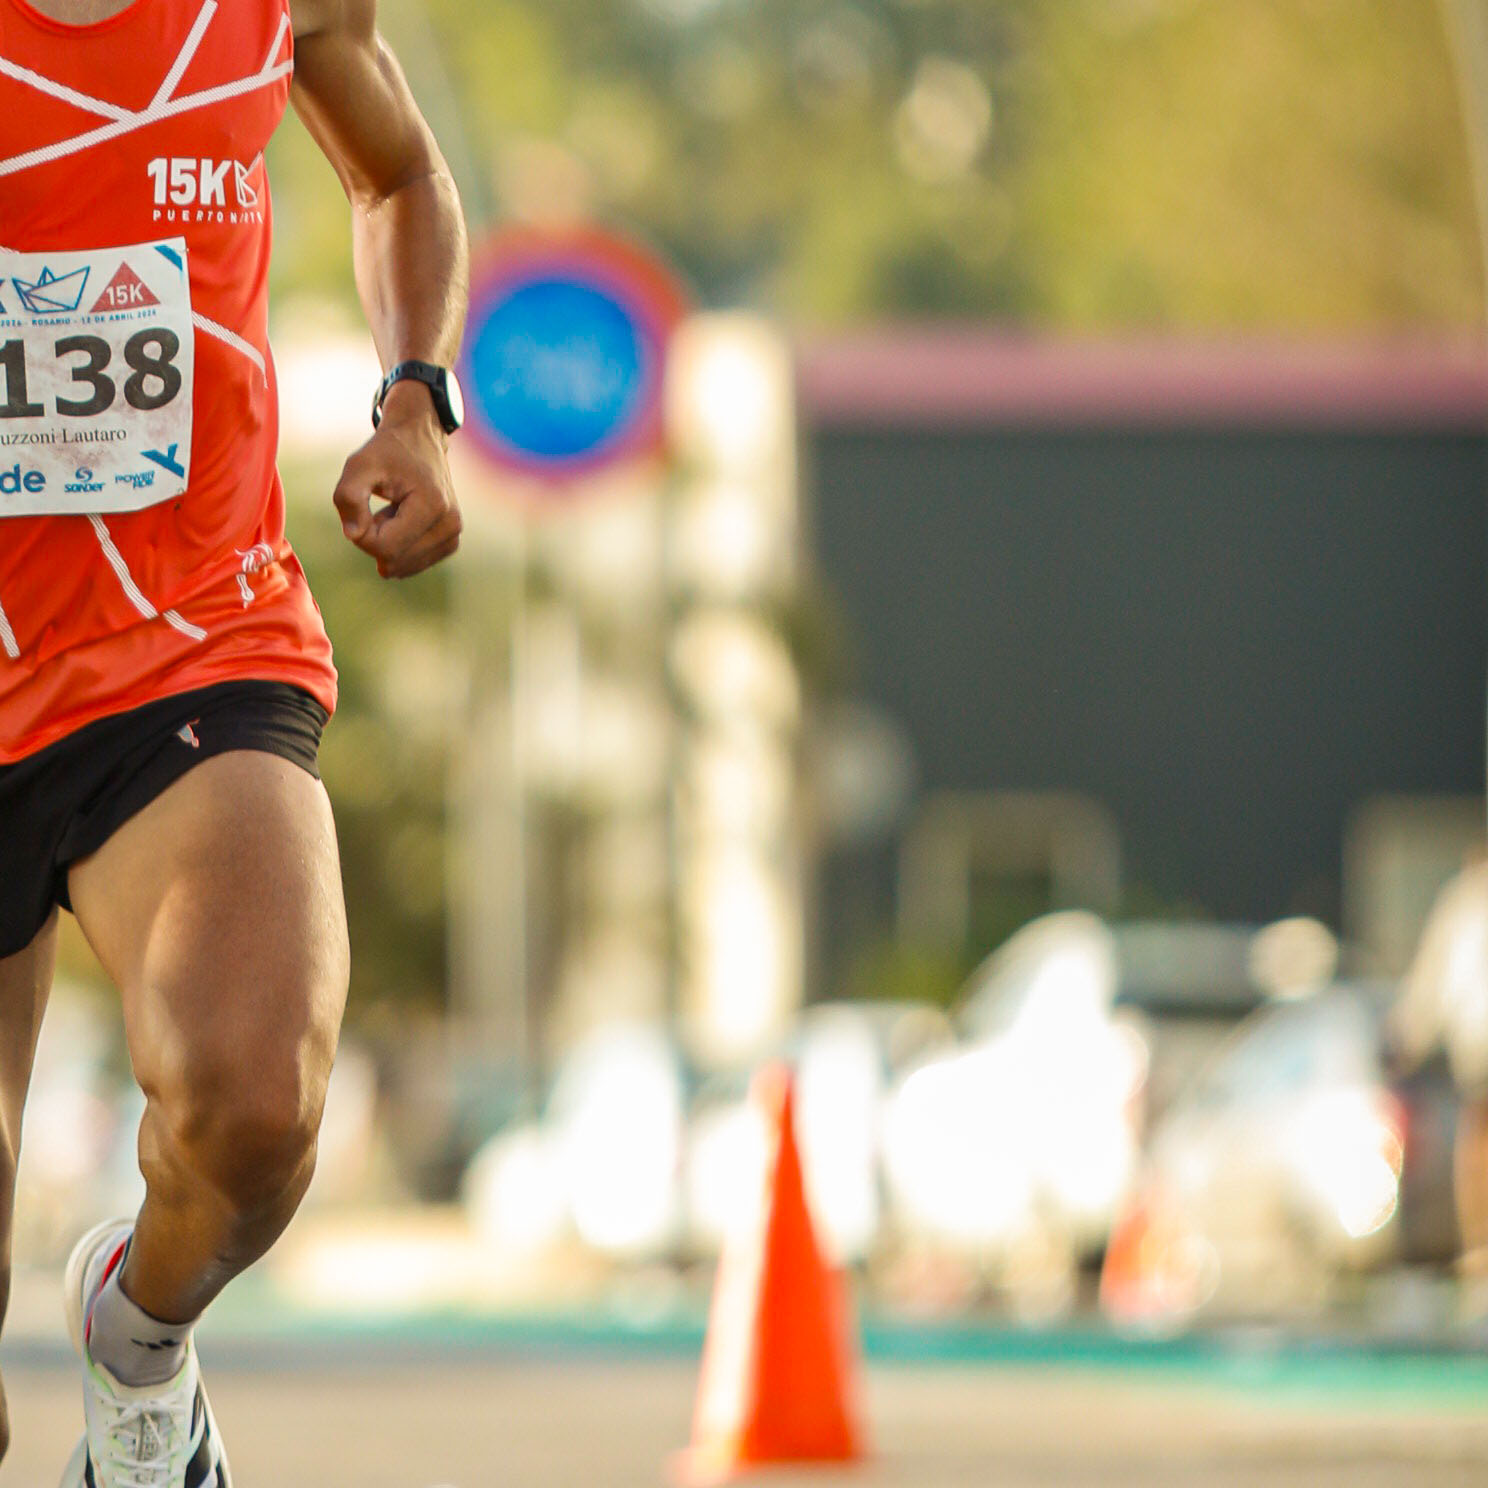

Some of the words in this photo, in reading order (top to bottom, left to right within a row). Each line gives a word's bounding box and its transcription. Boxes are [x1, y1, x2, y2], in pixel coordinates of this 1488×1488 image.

[147, 157, 232, 206] 15K
[153, 209, 223, 223] PUERTO
[106, 281, 144, 307] 15K
[31, 317, 71, 326] ROSARIO
[94, 315, 105, 323] DE
[109, 312, 134, 321] ABRIL
[62, 426, 127, 444] Lautaro
